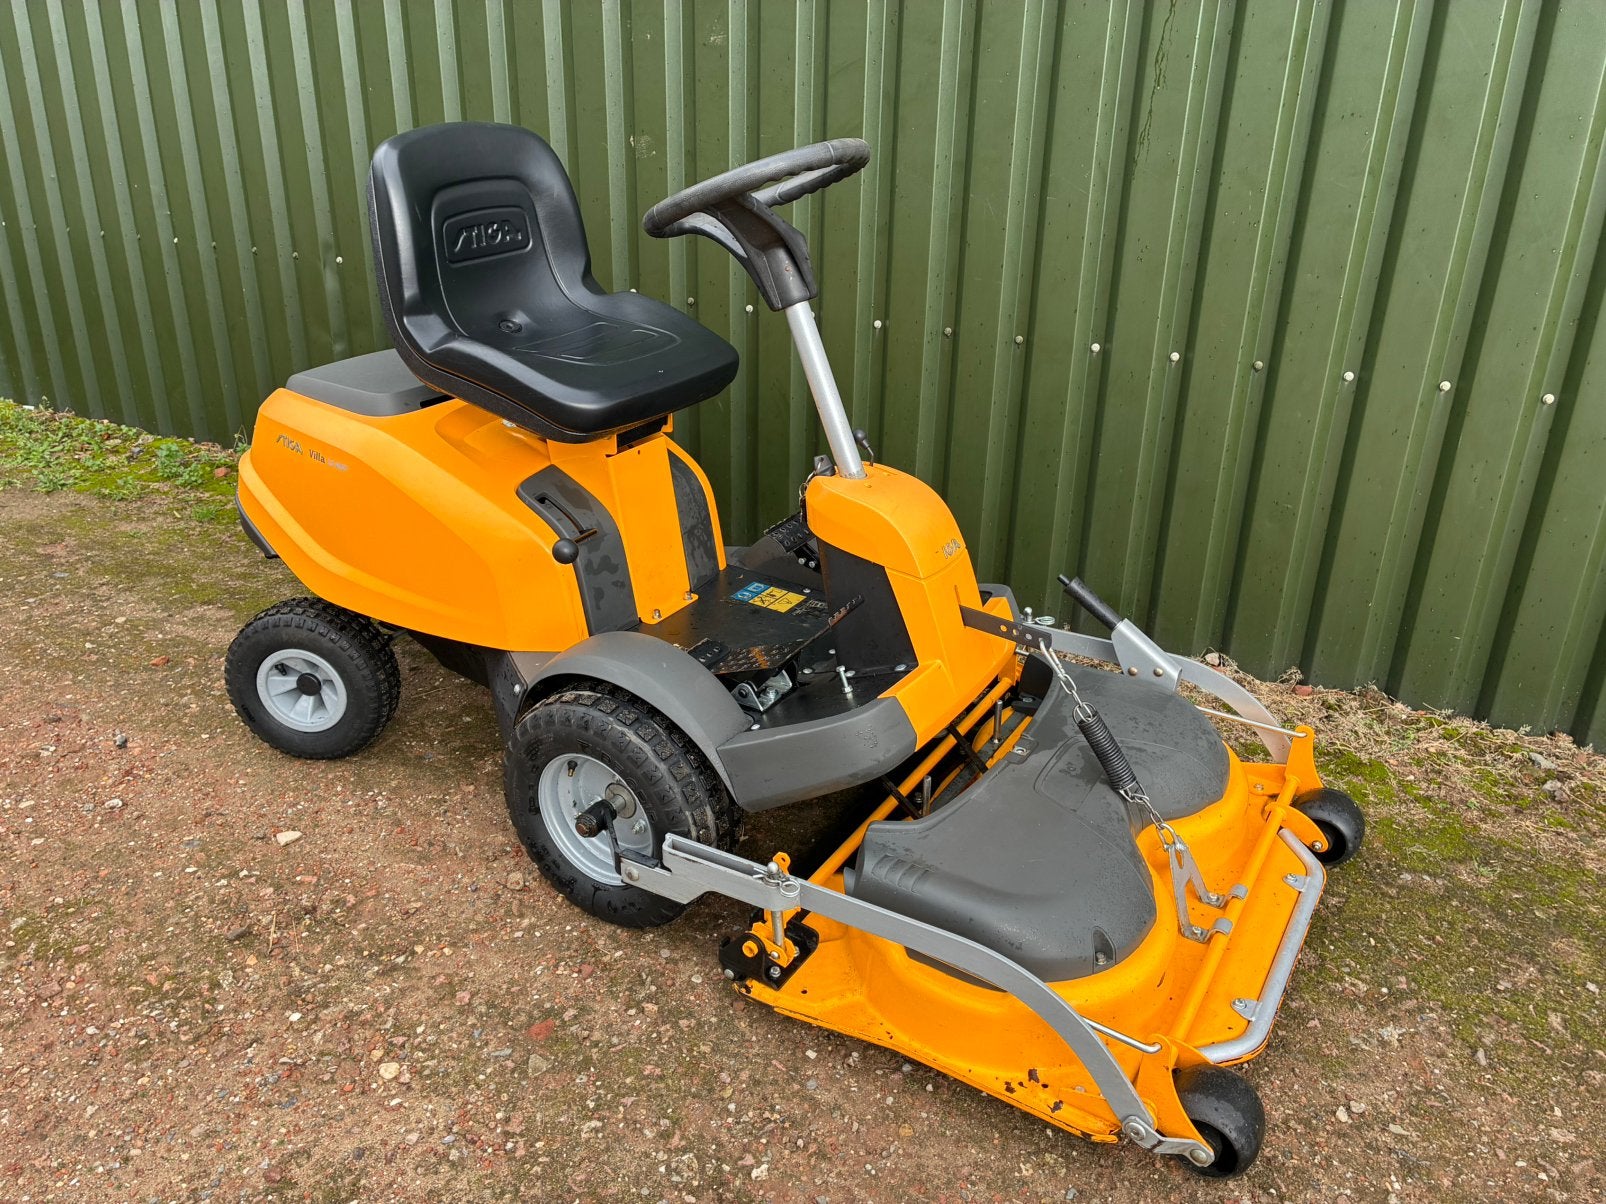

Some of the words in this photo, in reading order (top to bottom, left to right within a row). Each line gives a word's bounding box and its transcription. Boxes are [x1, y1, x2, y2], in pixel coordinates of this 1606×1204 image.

[453, 220, 522, 252] STIGA
[276, 434, 304, 455] STIGA
[309, 449, 326, 464] Villa
